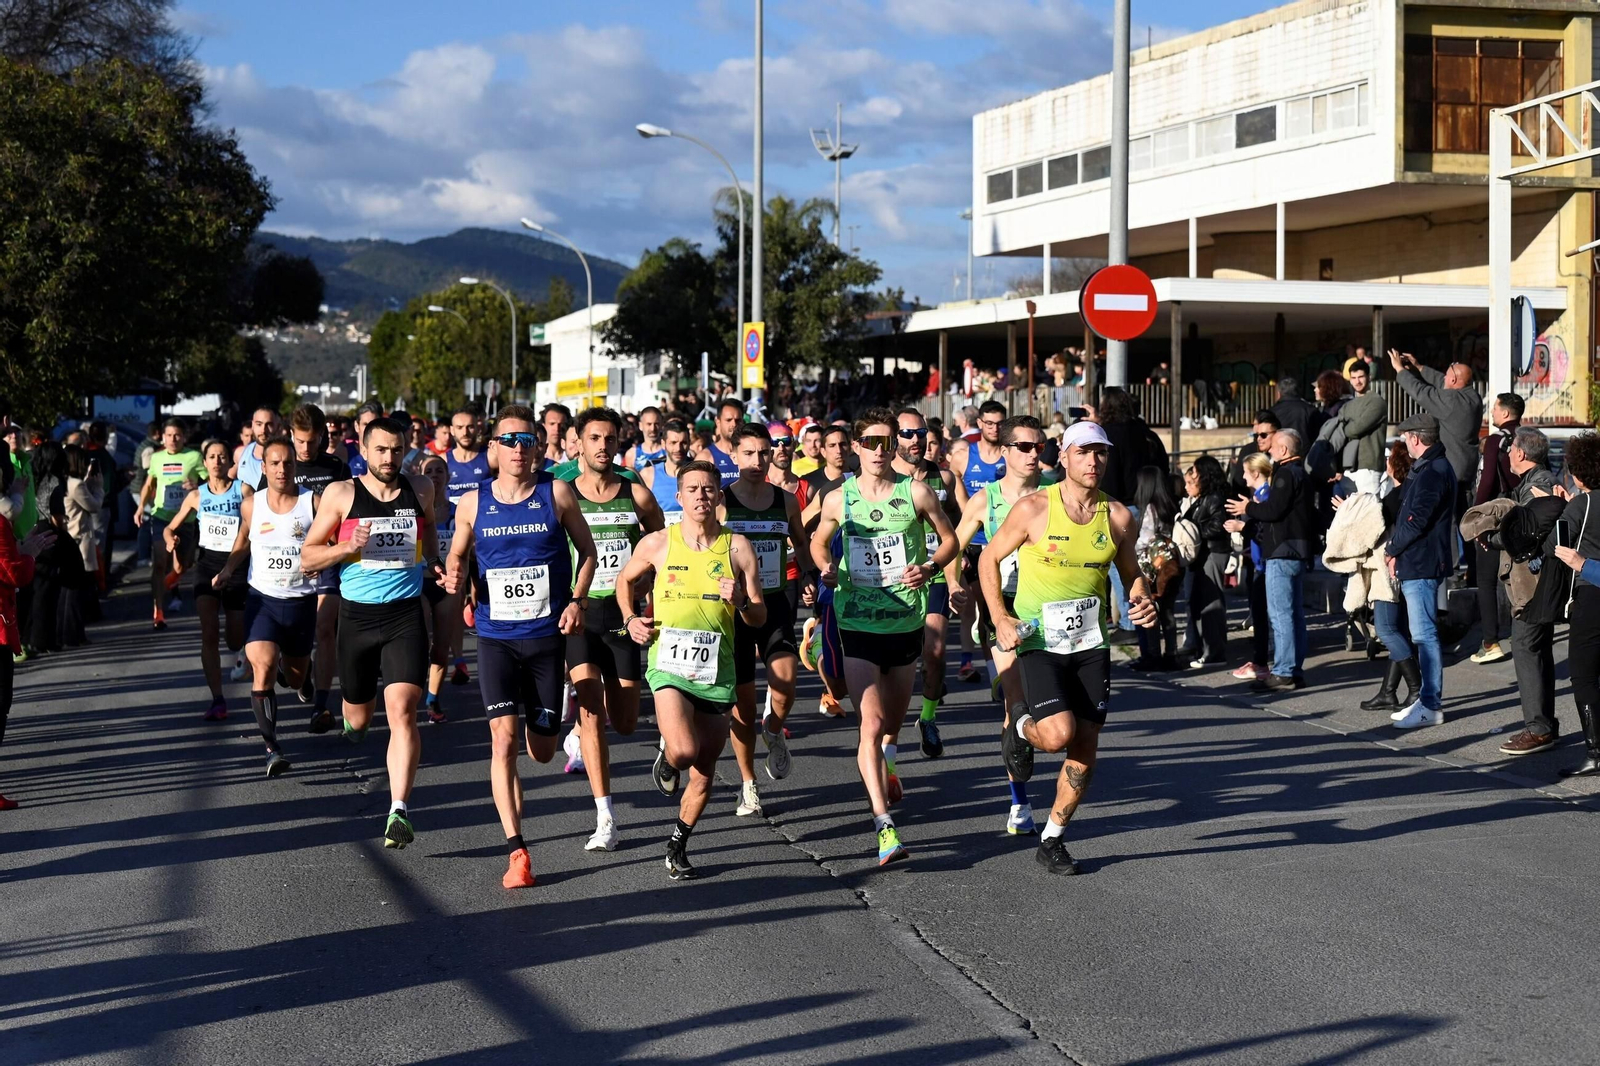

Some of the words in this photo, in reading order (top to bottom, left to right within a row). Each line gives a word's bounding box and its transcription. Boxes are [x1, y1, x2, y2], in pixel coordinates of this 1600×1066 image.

[208, 524, 228, 537] 668
[482, 523, 549, 537] TROTASIERRA
[375, 532, 405, 548] 332
[267, 557, 293, 570] 299
[864, 551, 893, 567] 315
[504, 583, 536, 599] 863
[1065, 614, 1084, 631] 23
[670, 643, 710, 663] 1170
